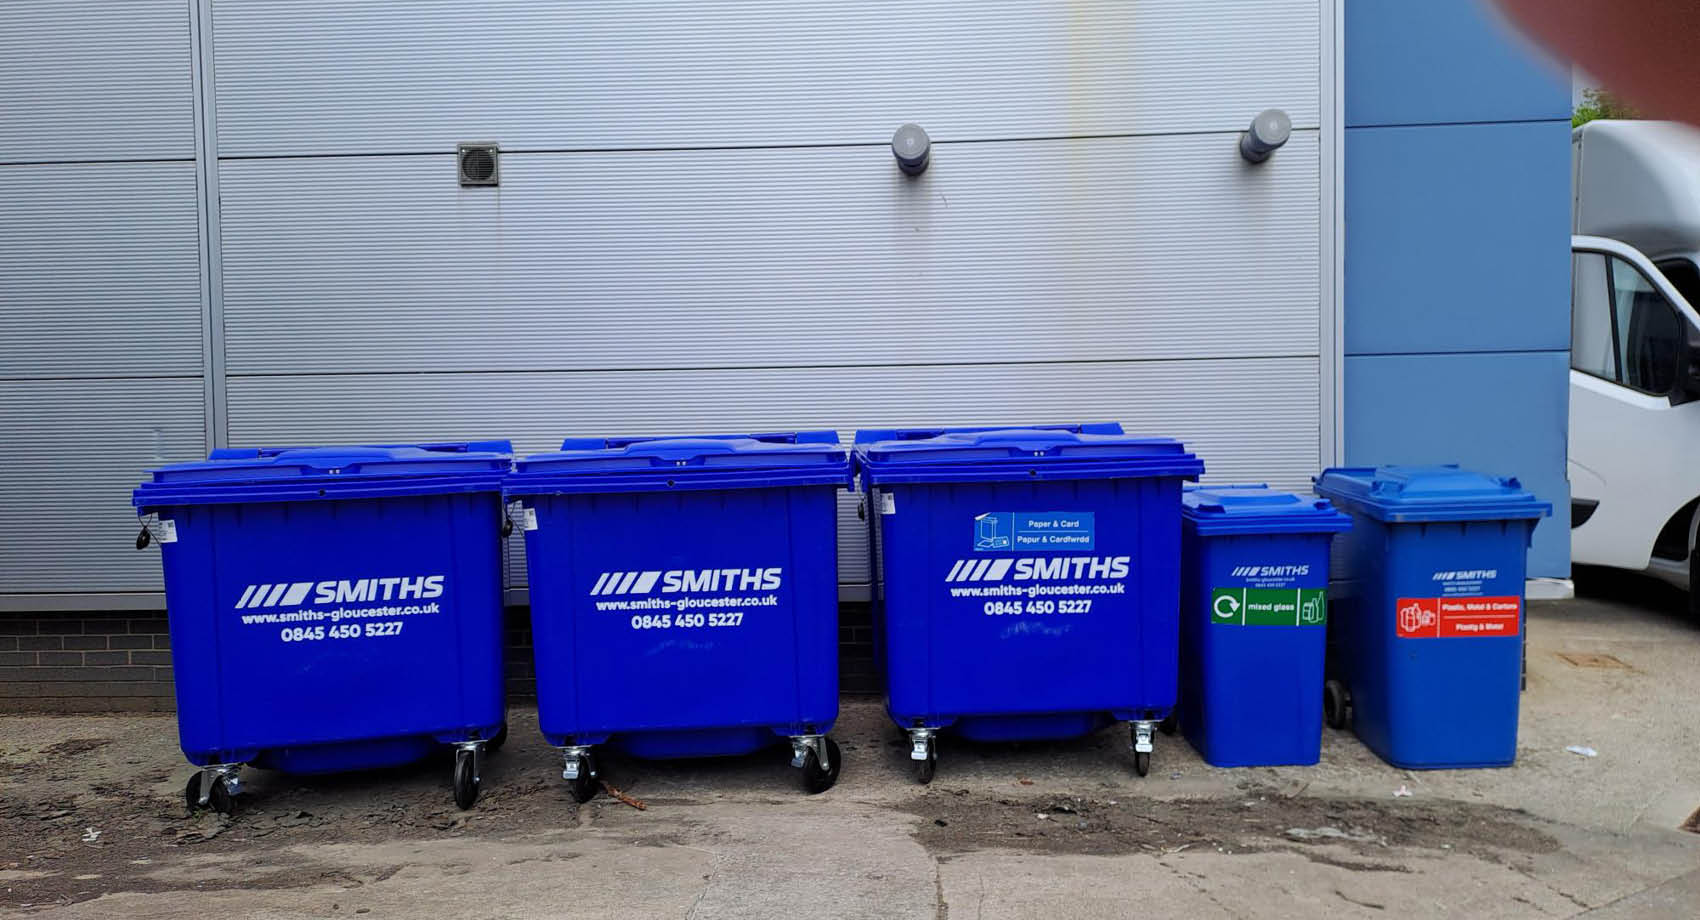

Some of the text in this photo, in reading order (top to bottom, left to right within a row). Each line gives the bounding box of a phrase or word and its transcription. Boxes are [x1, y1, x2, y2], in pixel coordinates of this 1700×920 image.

[1028, 520, 1051, 529] Paper
[1017, 535, 1040, 544] Papur
[1042, 535, 1047, 543] &
[1013, 556, 1130, 580] SMITHS
[1260, 565, 1309, 577] SMITHS
[1456, 570, 1497, 579] SMITHS
[662, 568, 782, 593] SMITHS
[314, 575, 445, 604] SMITHS
[950, 582, 1125, 599] www.smiths-gloucester.co.uk
[596, 594, 778, 612] www.smiths-gloucester.co.uk
[984, 600, 1092, 615] 0845 450 5227
[1248, 602, 1295, 612] mixed glass
[242, 602, 440, 624] www.smiths-gloucester.co.uk
[631, 612, 743, 629] 0845 450 5227
[281, 622, 403, 642] 0845 450 5227
